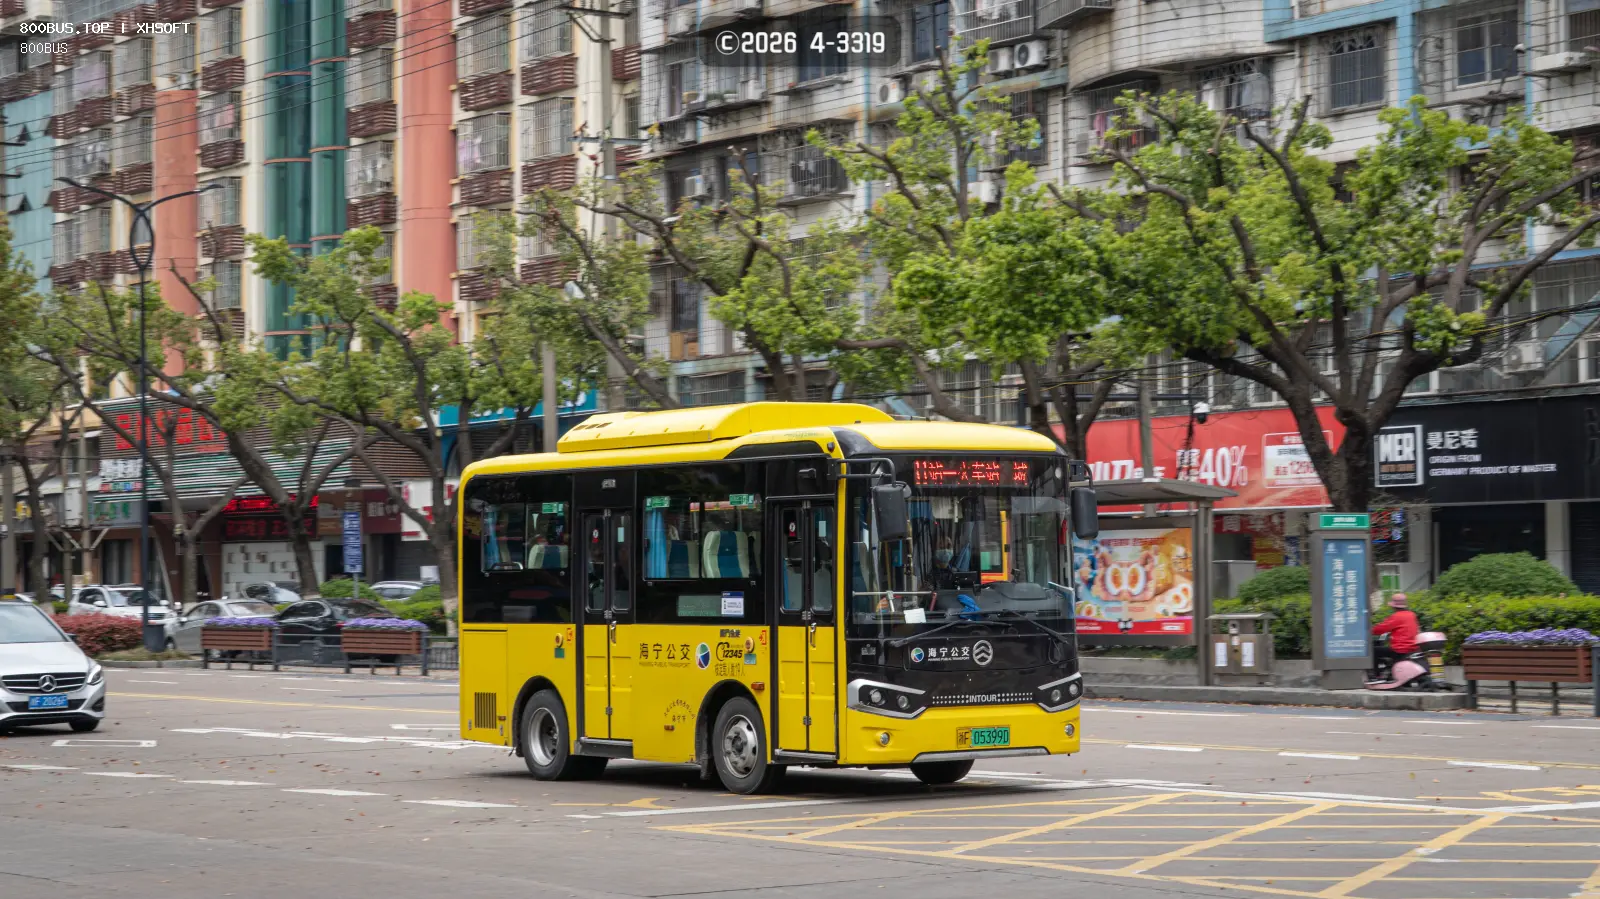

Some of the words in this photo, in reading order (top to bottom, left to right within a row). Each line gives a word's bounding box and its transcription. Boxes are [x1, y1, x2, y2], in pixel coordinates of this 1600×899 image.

[1199, 445, 1248, 487] 40%
[1469, 465, 1508, 475] PRODUCT
[1508, 465, 1521, 474] OF
[640, 642, 691, 660] 海宁公交
[722, 649, 743, 660] 12345
[928, 646, 970, 658] 海宁公交
[969, 694, 997, 703] INTOUR
